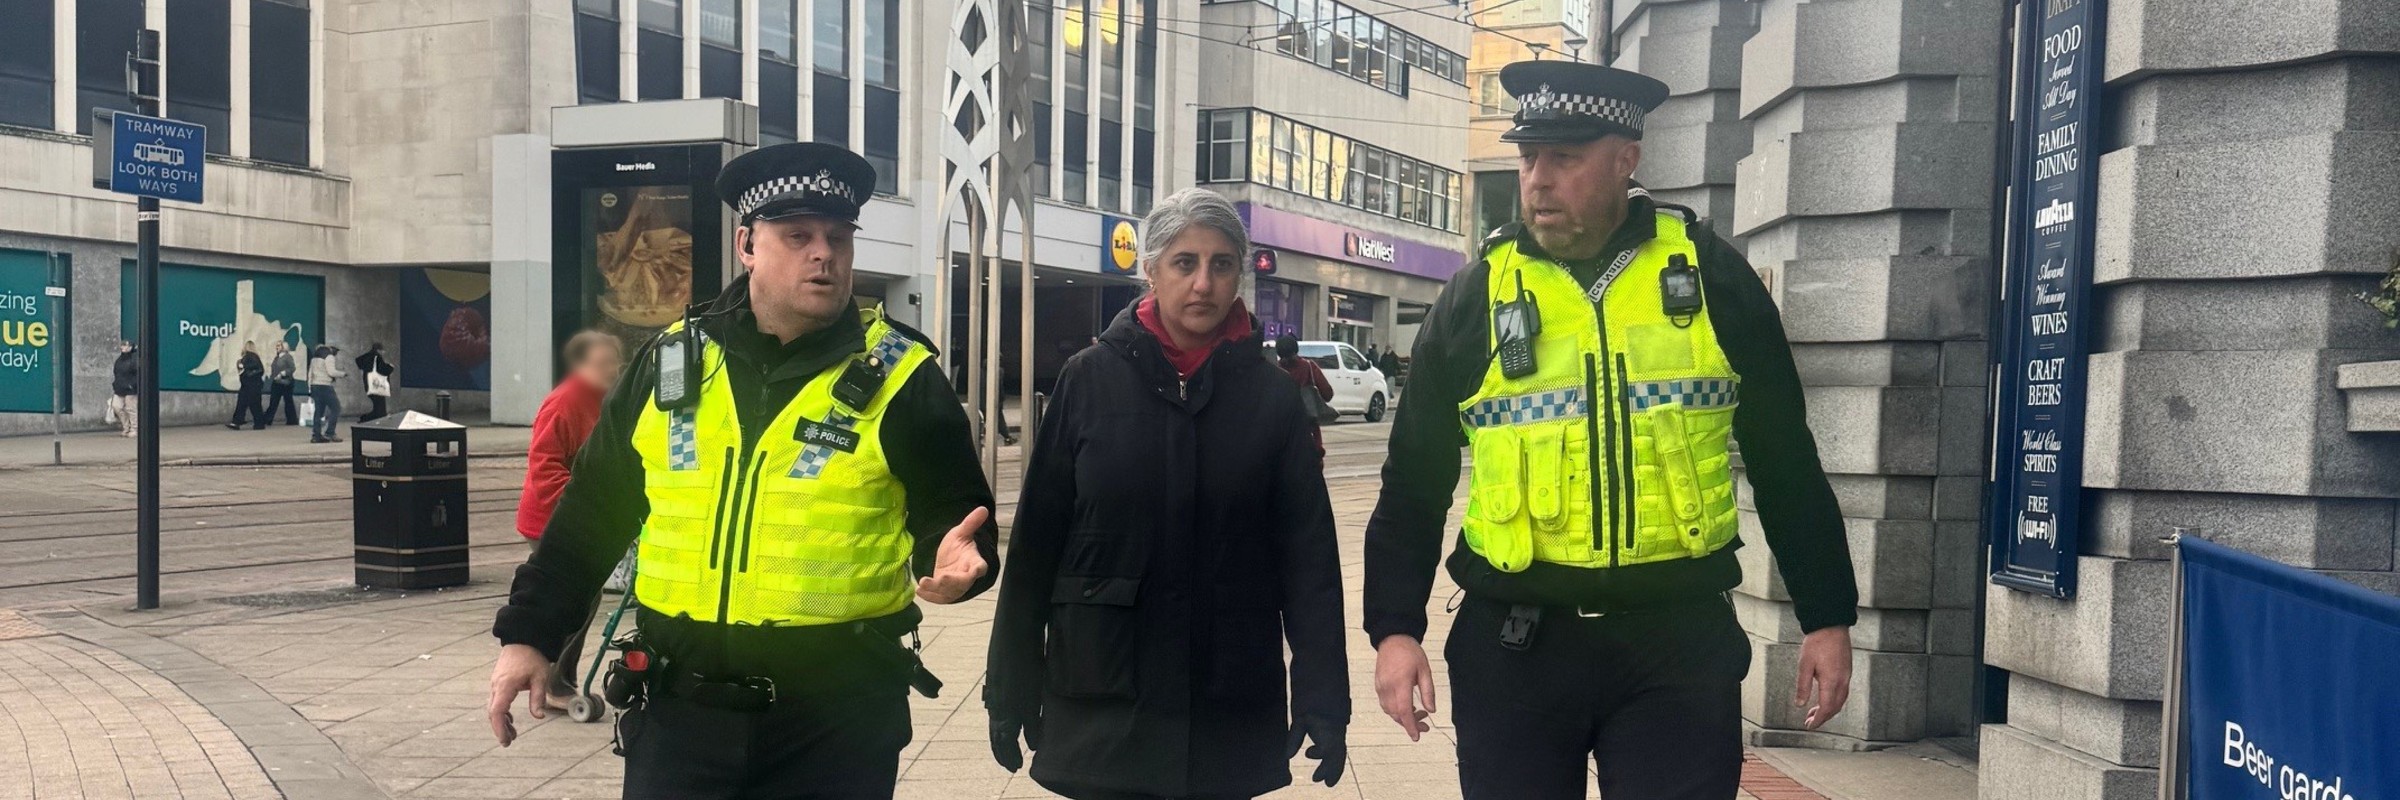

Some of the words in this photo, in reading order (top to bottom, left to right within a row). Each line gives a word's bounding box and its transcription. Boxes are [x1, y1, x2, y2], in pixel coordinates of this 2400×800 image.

[2047, 0, 2080, 19] DRA
[2043, 24, 2081, 63] FOOD
[2048, 54, 2075, 82] Served
[2042, 86, 2059, 110] All
[2058, 80, 2077, 109] Day
[126, 119, 194, 140] TRAMWAY
[2037, 121, 2078, 156] FAMILY
[119, 161, 156, 177] LOOK
[161, 167, 198, 183] BOTH
[615, 163, 635, 171] Bauer
[635, 162, 656, 171] Media
[2035, 148, 2078, 182] DINING
[139, 179, 178, 194] WAYS
[2035, 198, 2074, 229] LAVAZZA
[2042, 223, 2067, 237] COFFEE
[1358, 236, 1395, 263] NatWest
[2037, 257, 2067, 281] Award
[0, 290, 37, 316] zing
[2035, 283, 2066, 311] Winning
[2, 320, 49, 347] ue
[180, 320, 236, 337] Poundl
[2031, 311, 2068, 336] WINES
[0, 348, 38, 372] day!
[2028, 357, 2065, 381] CRAFT
[2027, 383, 2062, 406] BEERS
[820, 431, 851, 447] POLICE
[2022, 429, 2046, 451] World
[2044, 429, 2062, 451] Class
[2024, 453, 2057, 473] SPIRITS
[2027, 495, 2049, 513] FREE
[2223, 720, 2274, 789] Beer
[2280, 764, 2354, 800] gard
